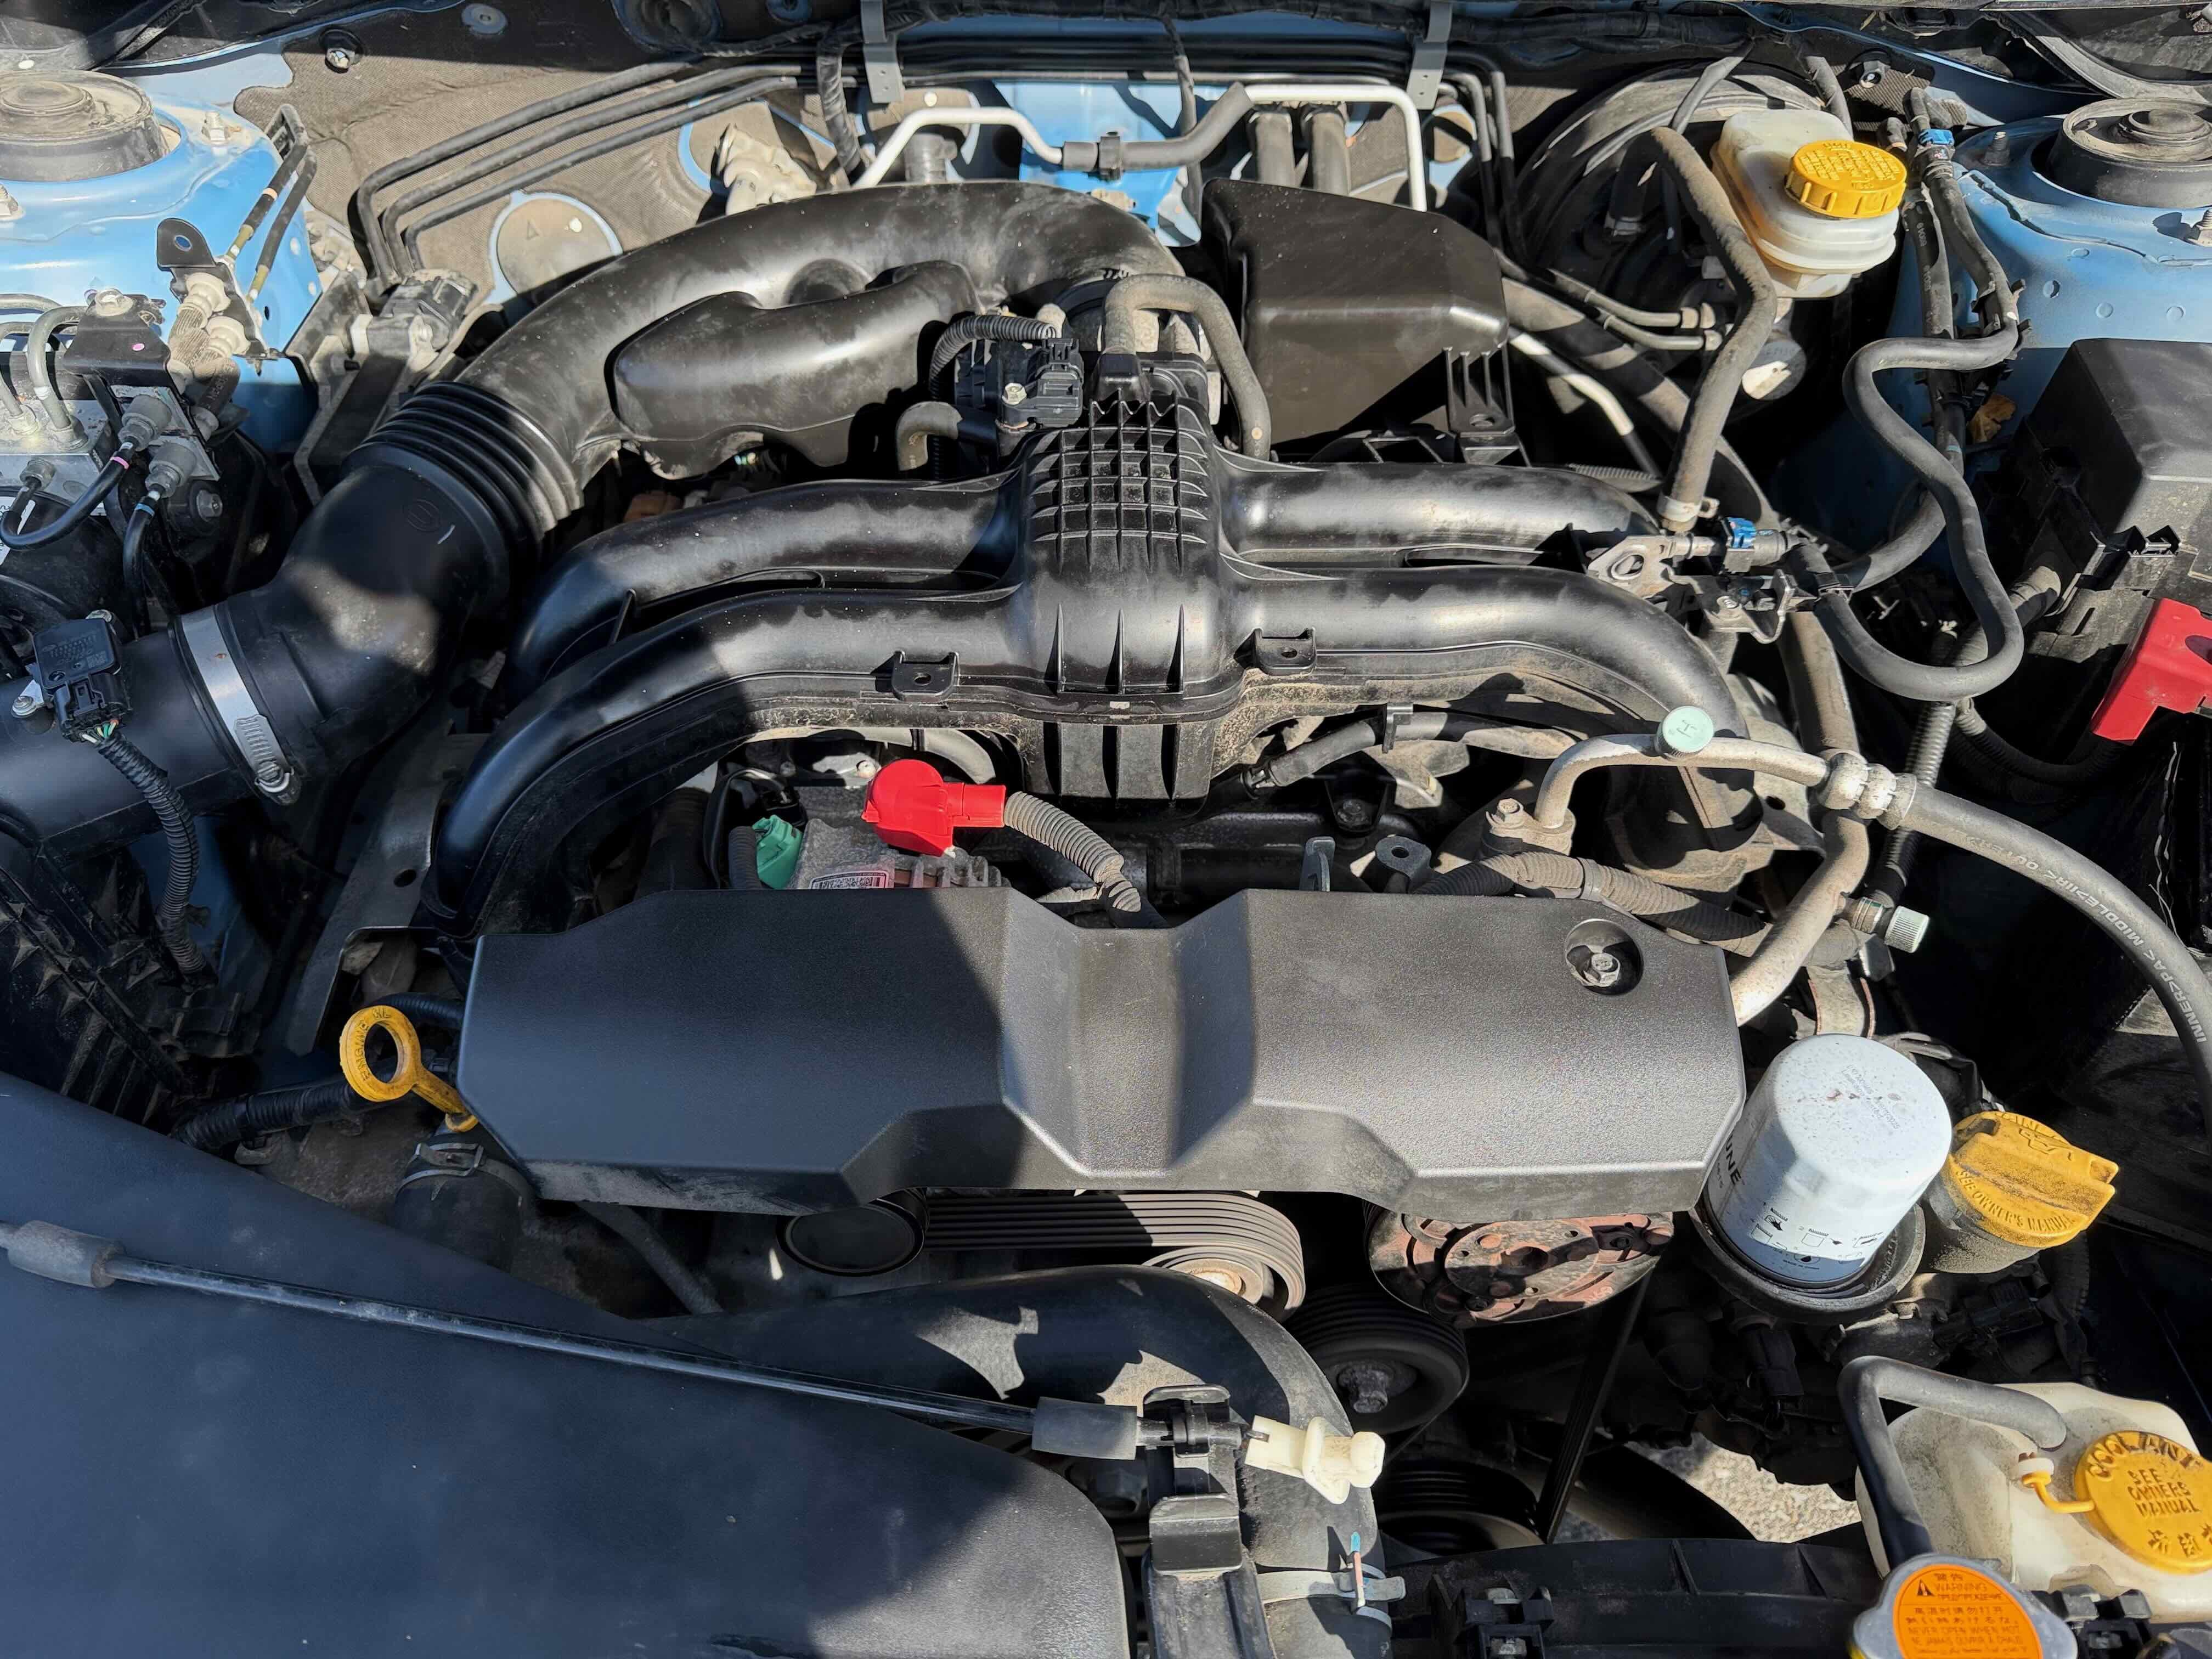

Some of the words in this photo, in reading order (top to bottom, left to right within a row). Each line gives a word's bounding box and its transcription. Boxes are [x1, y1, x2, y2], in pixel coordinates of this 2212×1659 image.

[1956, 1170, 1976, 1191] SEE
[1972, 1191, 2024, 1228] OWNER'S
[2027, 1213, 2076, 1231] MANUAL
[2086, 1432, 2204, 1481] COOLANT
[2128, 1468, 2163, 1486] SEE
[2135, 1497, 2202, 1519] MANUAL
[1935, 1583, 1988, 1592] WARNING
